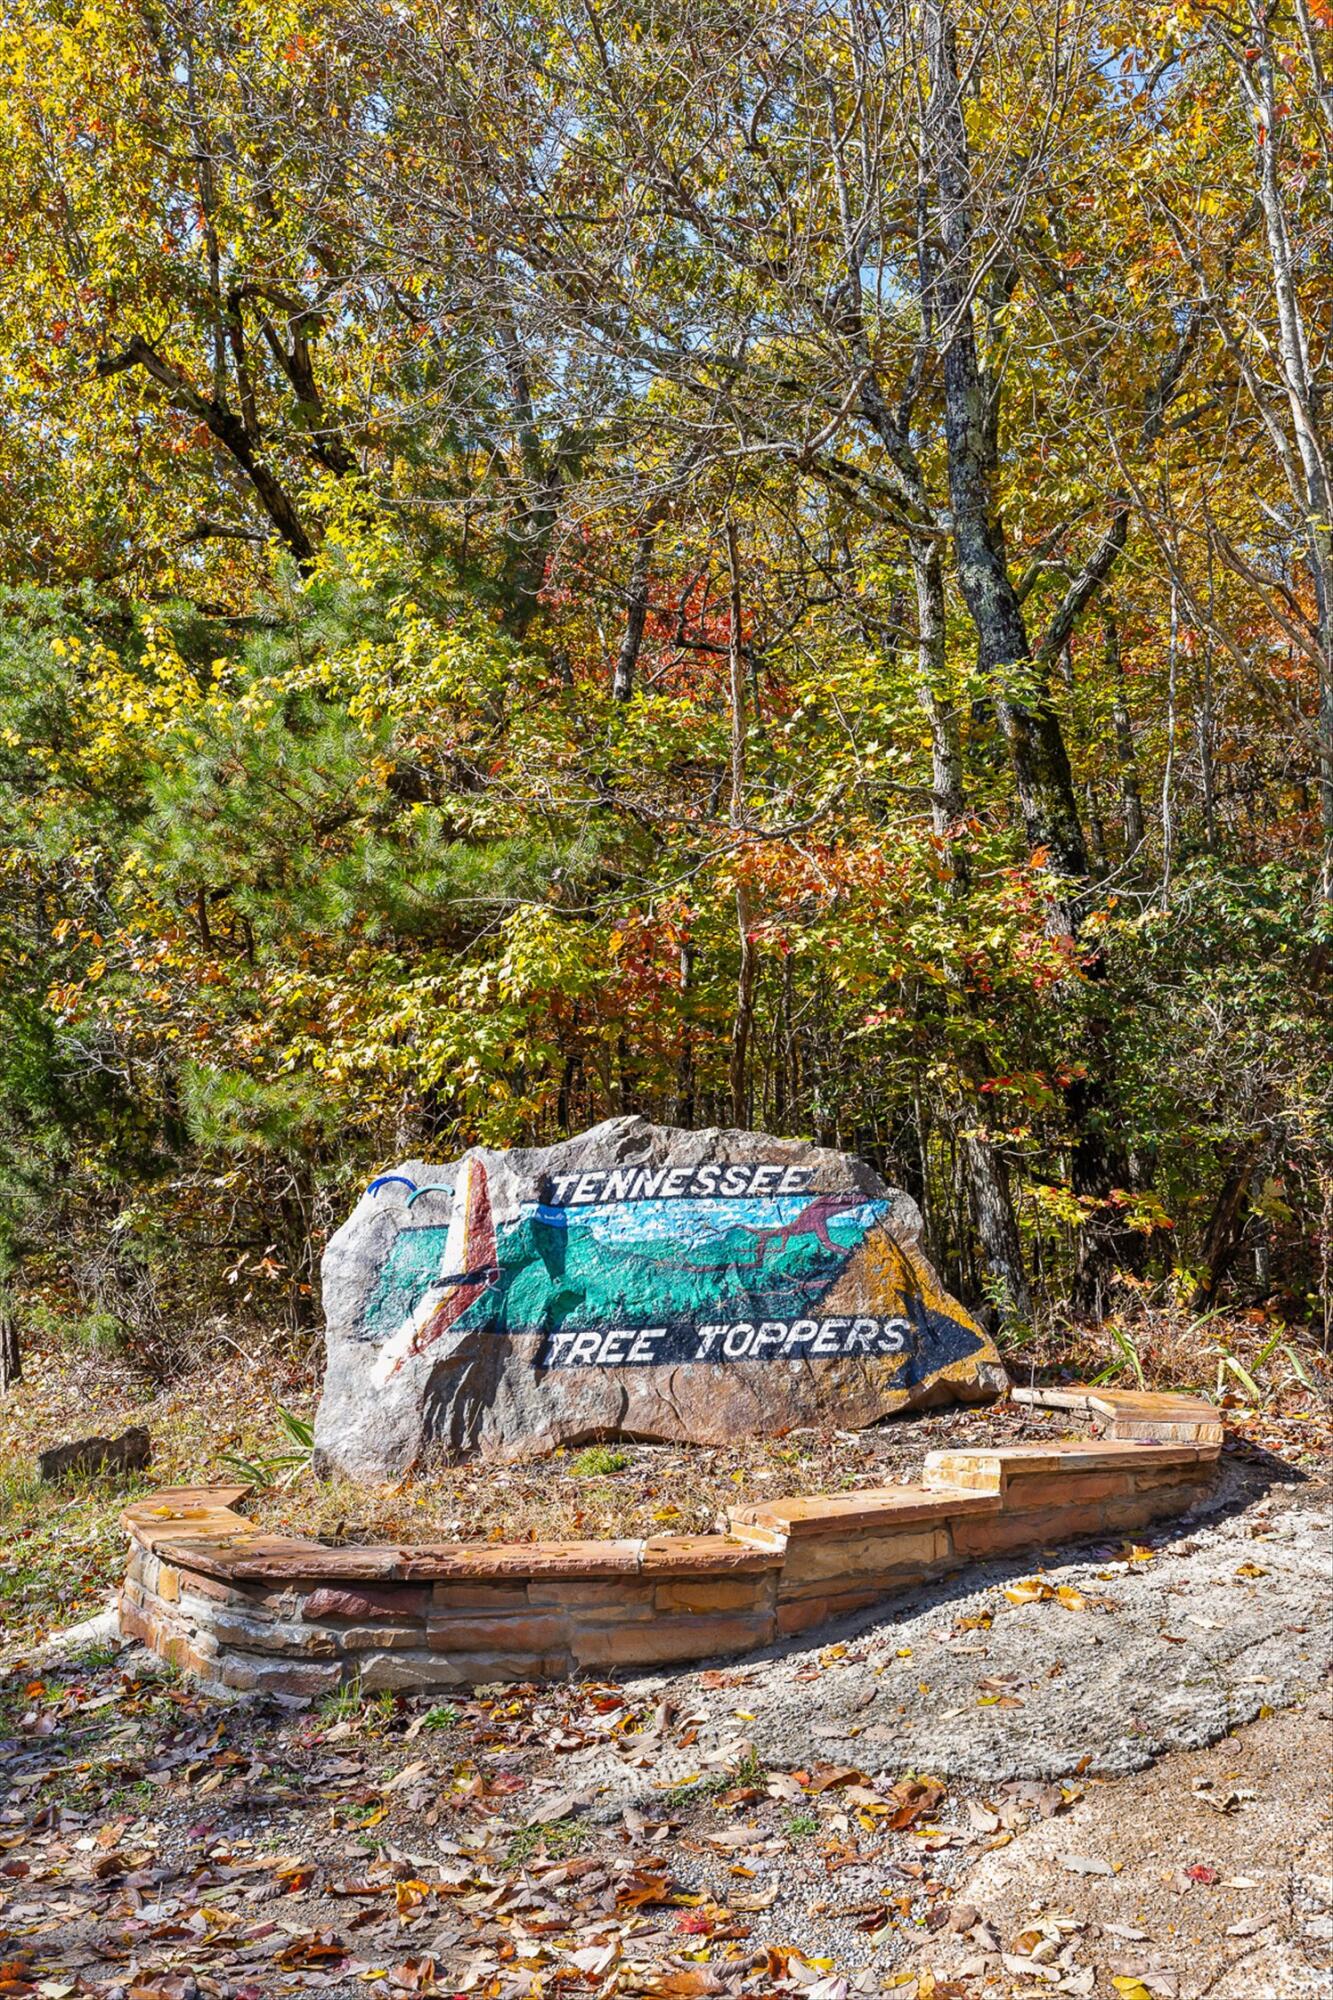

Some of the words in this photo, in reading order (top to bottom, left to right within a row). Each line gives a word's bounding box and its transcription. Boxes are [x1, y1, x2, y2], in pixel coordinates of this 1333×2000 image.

[551, 1165, 810, 1205] TENNESSEE
[548, 1329, 667, 1366] TREE
[695, 1320, 911, 1359] TOPPERS
